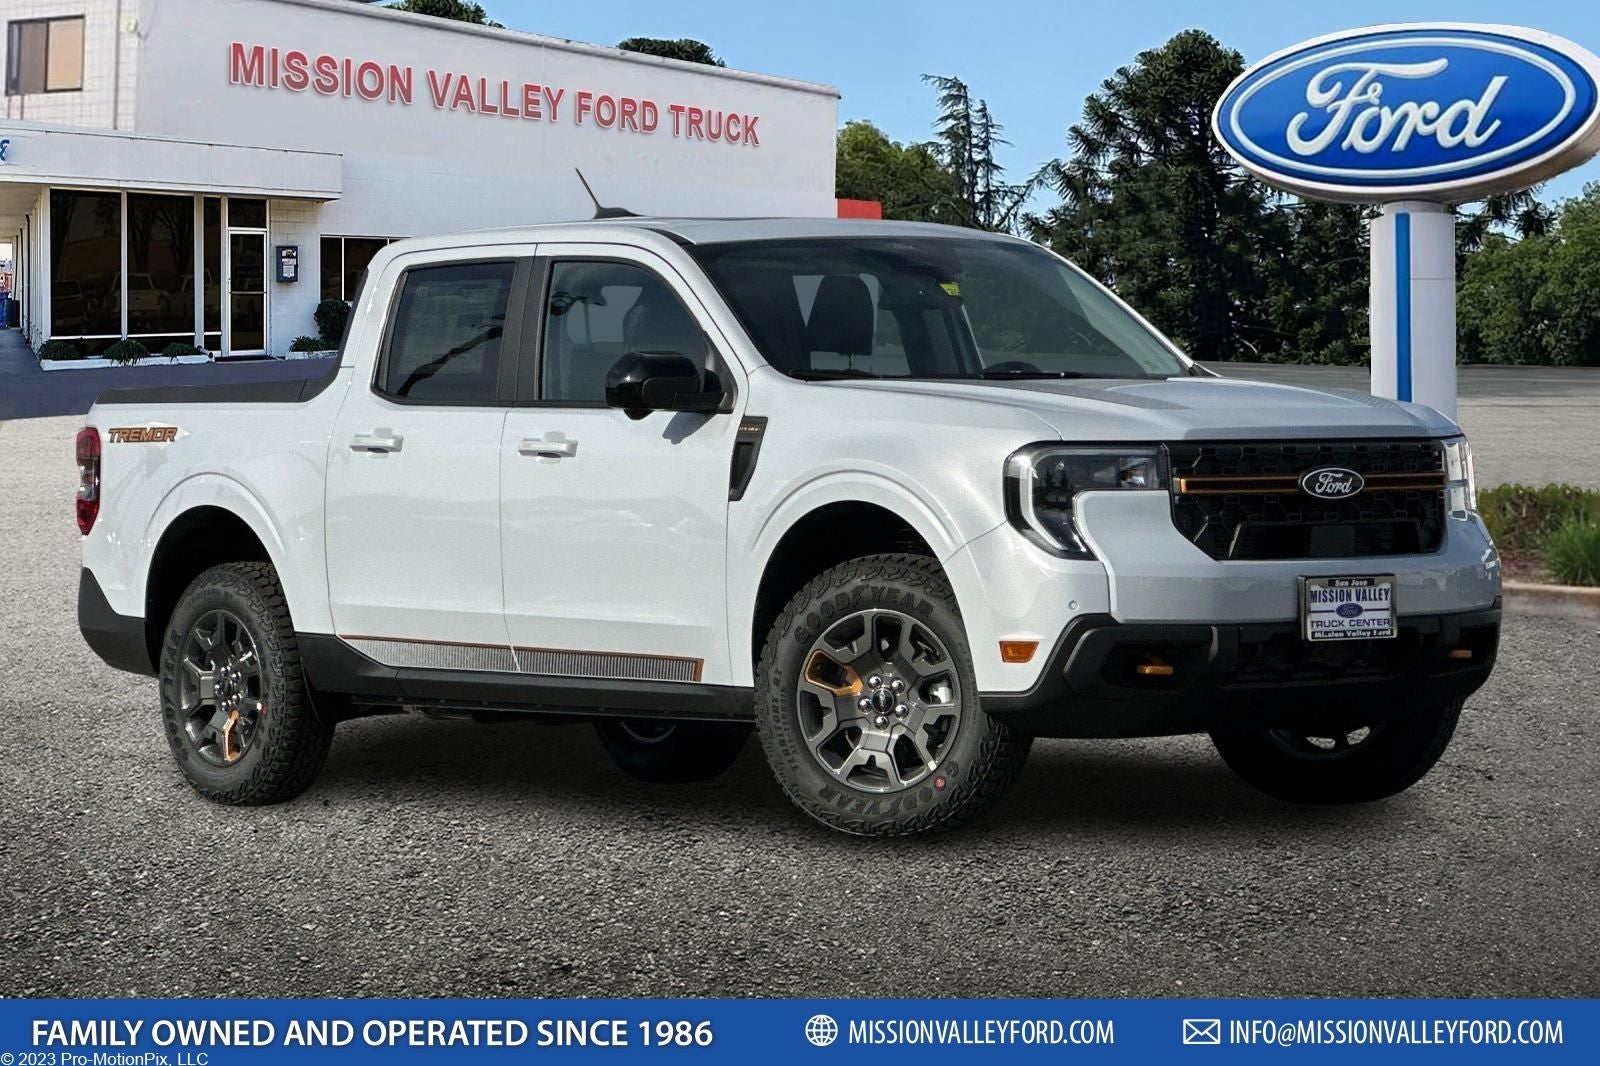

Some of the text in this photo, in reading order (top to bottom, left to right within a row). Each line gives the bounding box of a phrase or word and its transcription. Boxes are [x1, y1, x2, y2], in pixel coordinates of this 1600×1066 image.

[230, 41, 761, 147] MISSION VALLEY FORD TRUCK
[1286, 58, 1509, 156] Ford
[108, 427, 178, 443] TREMOR
[1315, 472, 1353, 495] Ford
[1334, 579, 1368, 587] San Jose
[1310, 587, 1390, 604] MISSION VALLEY
[794, 584, 934, 645] GOODYEAR
[1311, 618, 1390, 629] TRUCK CENTER
[1314, 630, 1344, 638] Mission
[1346, 629, 1371, 638] Valley
